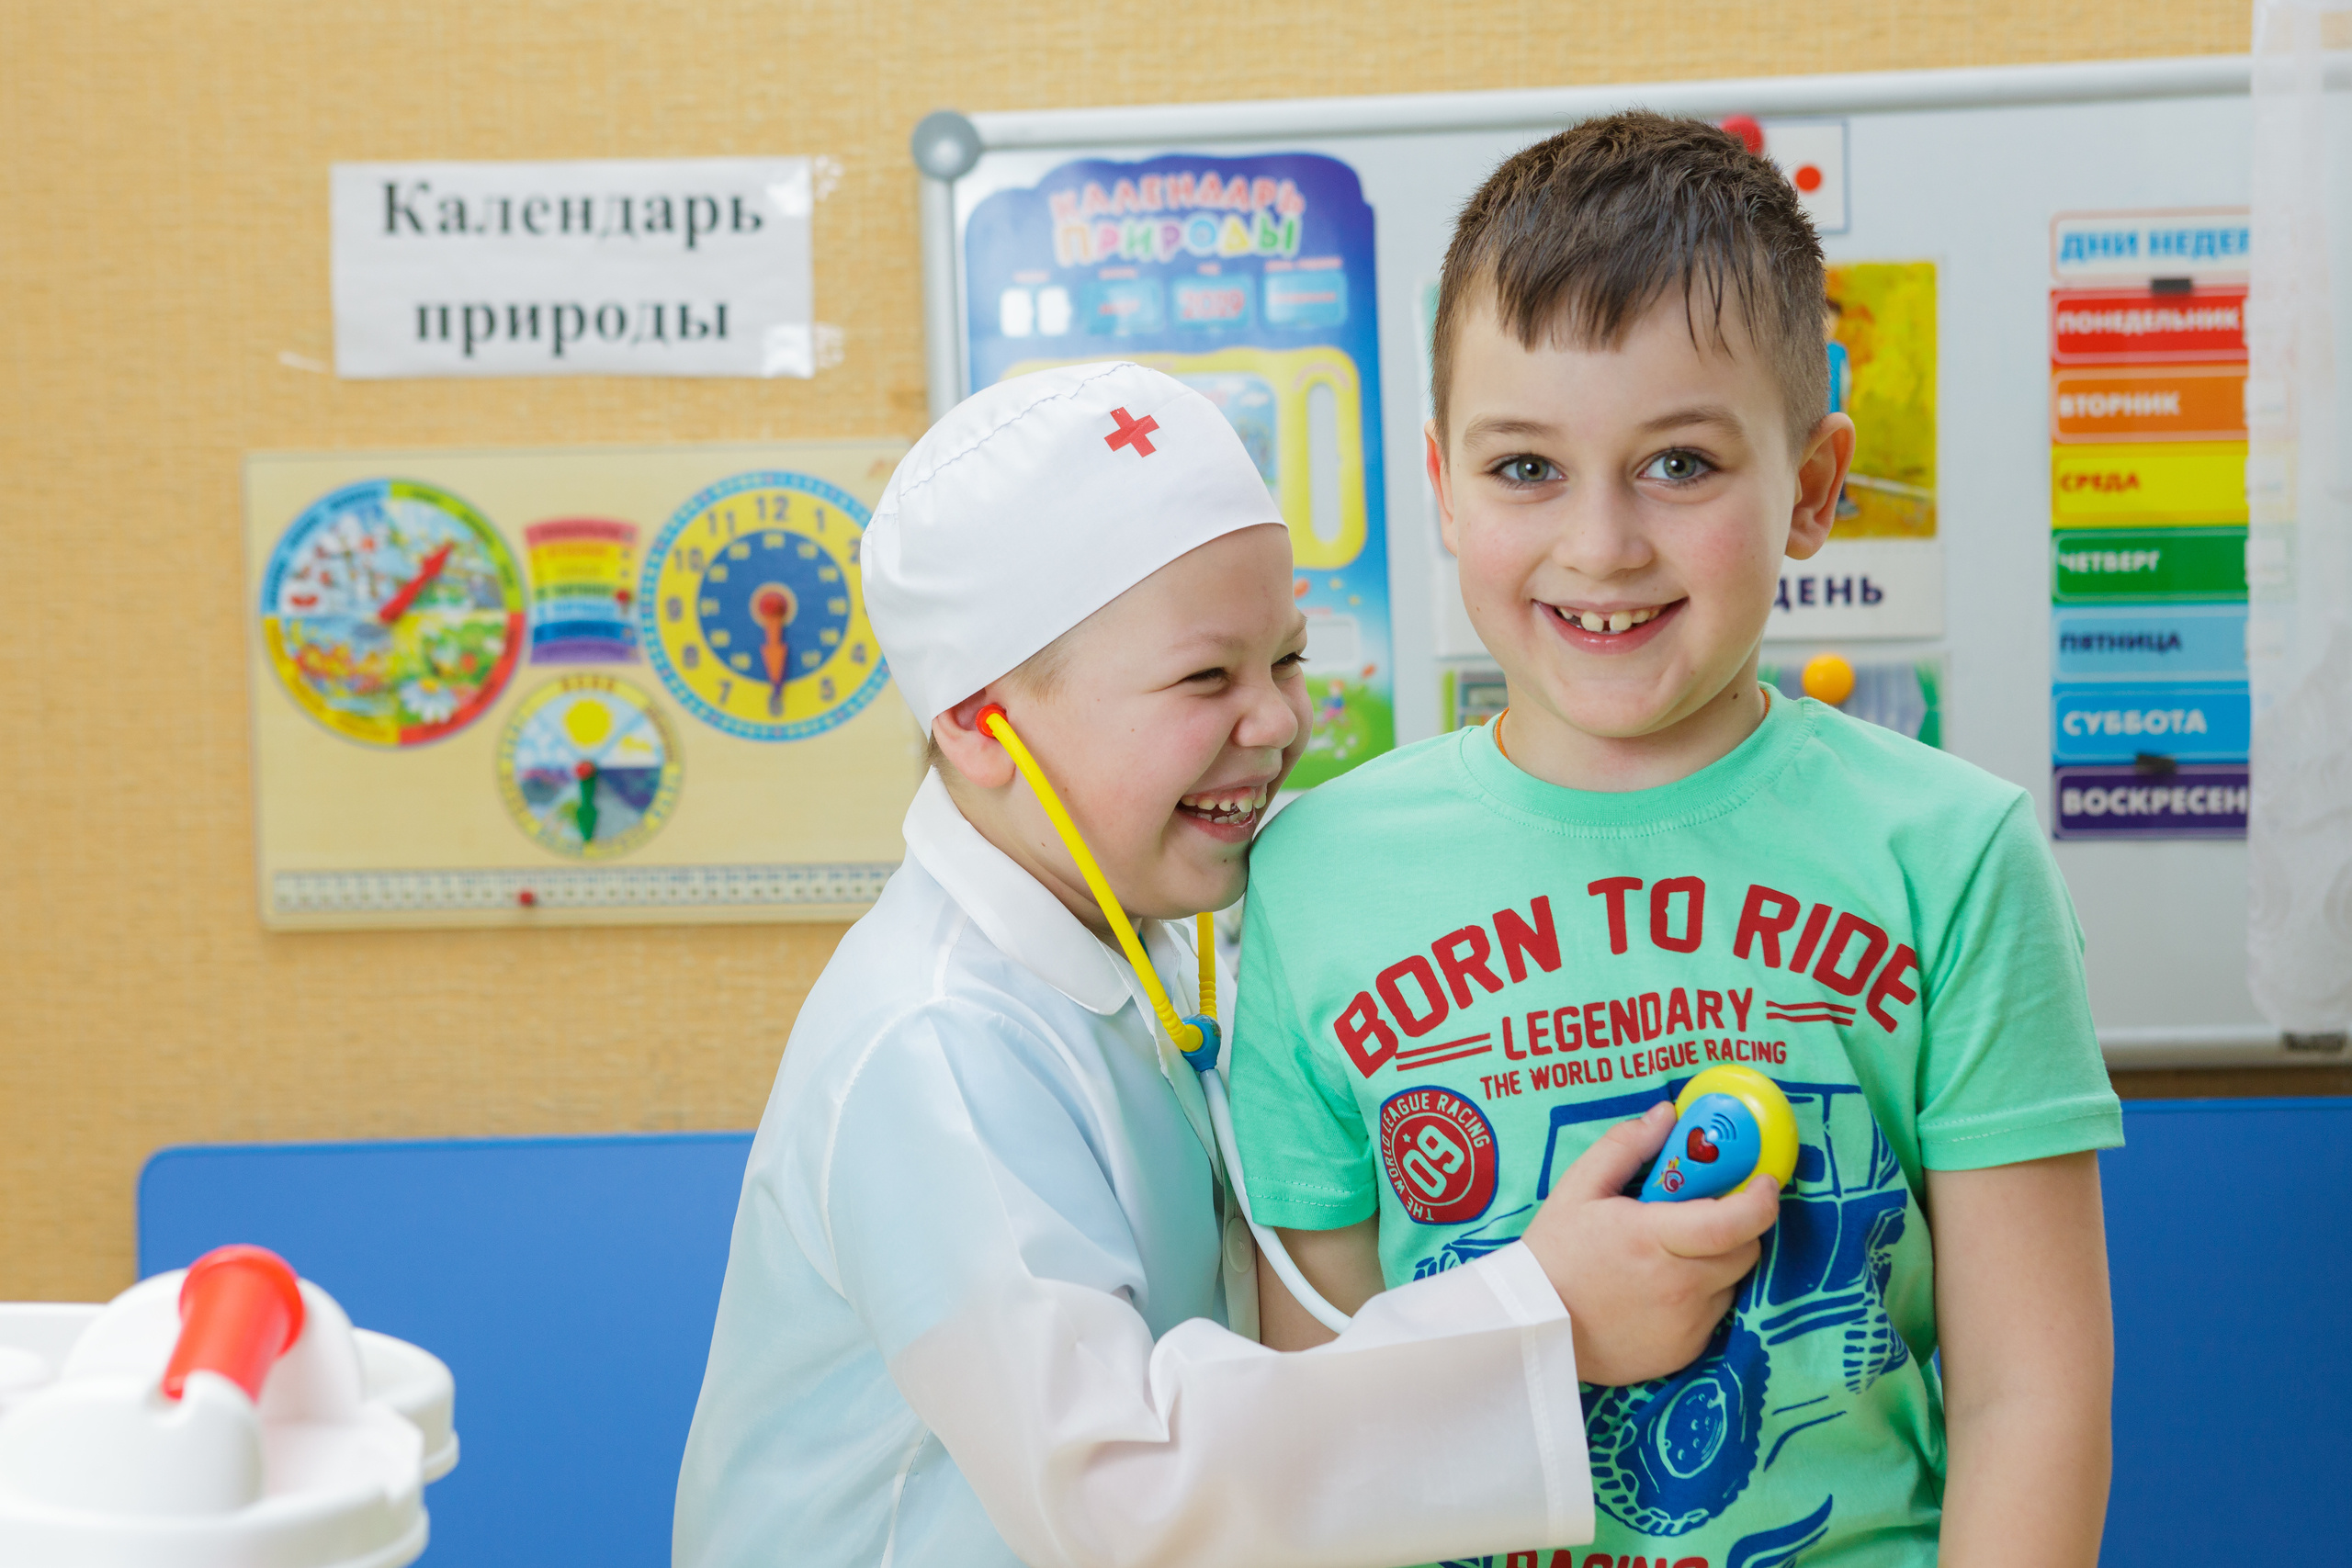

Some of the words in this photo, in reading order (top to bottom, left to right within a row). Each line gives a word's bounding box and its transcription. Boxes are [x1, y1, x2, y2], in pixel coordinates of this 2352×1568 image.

[381, 181, 764, 250] Календарь
[1056, 211, 1301, 266] ПРИРОДЫ
[2060, 231, 2139, 263] ДНИ
[413, 300, 729, 357] природы
[2058, 307, 2239, 336] ПОНЕДЕЛЬНИК
[2059, 390, 2181, 418] ВТОРНИК
[2060, 471, 2141, 493] СРЕДА
[2058, 549, 2162, 573] ЧЕТВЕРГ
[2060, 631, 2182, 653] ПЯТНИЦА
[2062, 708, 2208, 737] СУББОТА
[2061, 785, 2248, 817] ВОСКРЕСЕН
[1333, 894, 1563, 1079] BORN
[1587, 875, 1706, 955] TO
[1733, 884, 1921, 1034] RIDE
[1501, 987, 1754, 1061] LEGENDARY
[1479, 1070, 1522, 1100] THE
[1529, 1056, 1613, 1092] WORLD
[1620, 1041, 1700, 1079] LEAGUE
[1706, 1038, 1788, 1065] RACING
[1382, 1092, 1430, 1134] LEAGUE
[1436, 1093, 1491, 1148] RACING
[1382, 1134, 1406, 1194] WORLD
[1402, 1124, 1465, 1199] 09
[1407, 1196, 1435, 1222] THE
